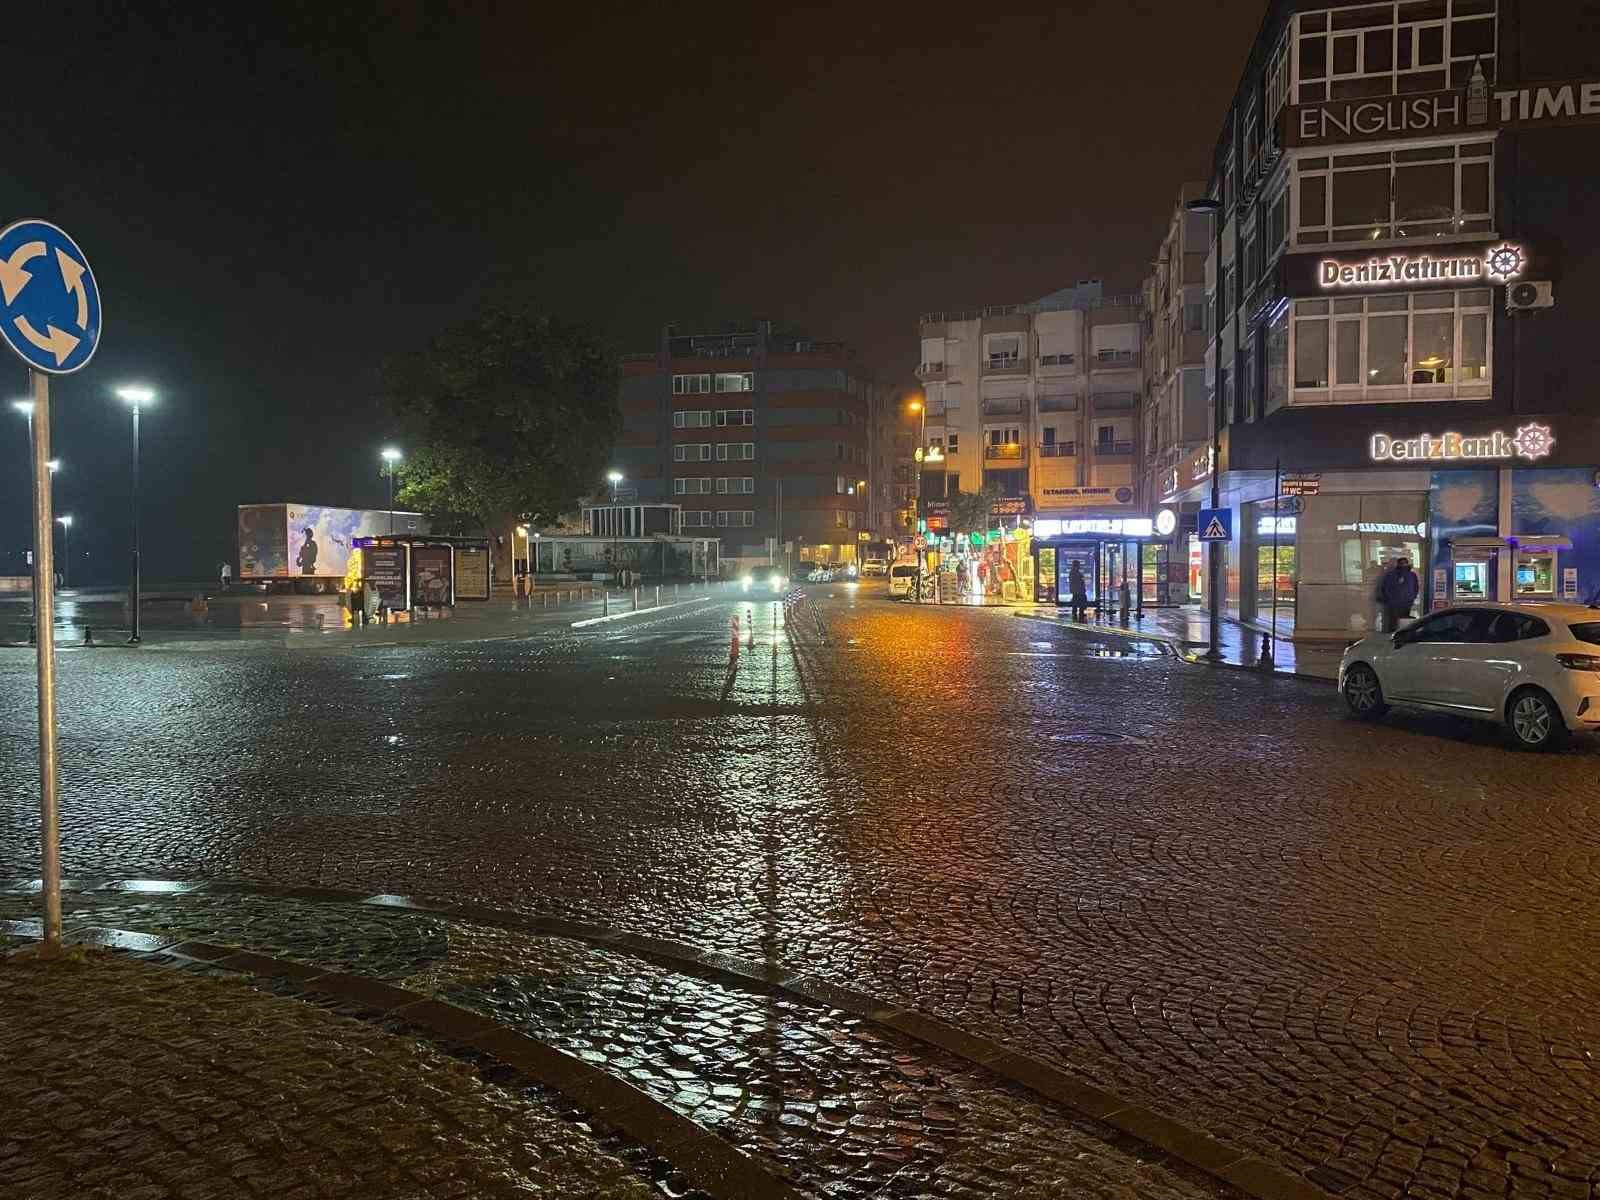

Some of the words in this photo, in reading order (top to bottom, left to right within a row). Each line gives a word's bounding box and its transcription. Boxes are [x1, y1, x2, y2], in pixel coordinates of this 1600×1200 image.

[1300, 97, 1458, 138] ENGLISH
[1493, 84, 1600, 121] TIME
[1321, 255, 1481, 285] DenizYatırım
[1372, 432, 1512, 460] DenizBank
[1289, 487, 1302, 495] WC
